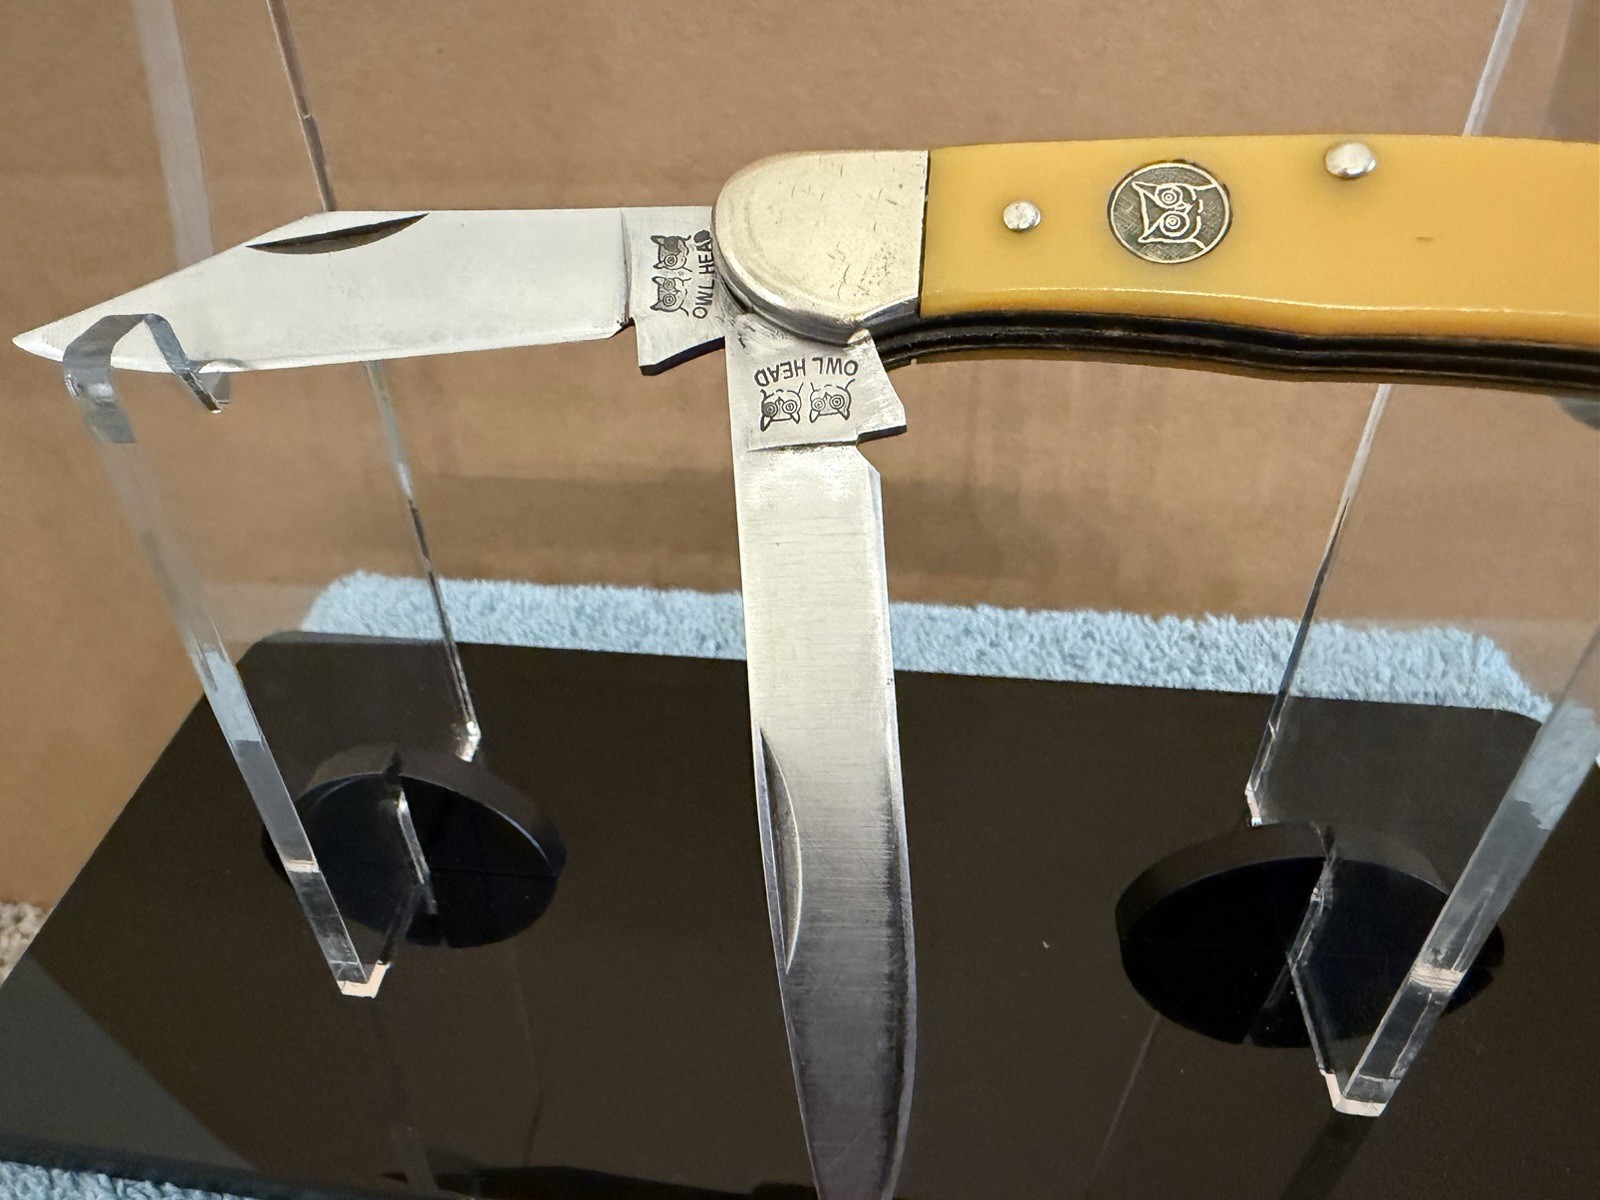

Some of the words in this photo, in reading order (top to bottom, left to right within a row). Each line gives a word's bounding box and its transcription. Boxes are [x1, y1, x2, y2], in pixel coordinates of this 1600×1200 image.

[692, 279, 715, 319] OWL
[754, 357, 806, 387] HEAD
[812, 357, 859, 376] OWL
